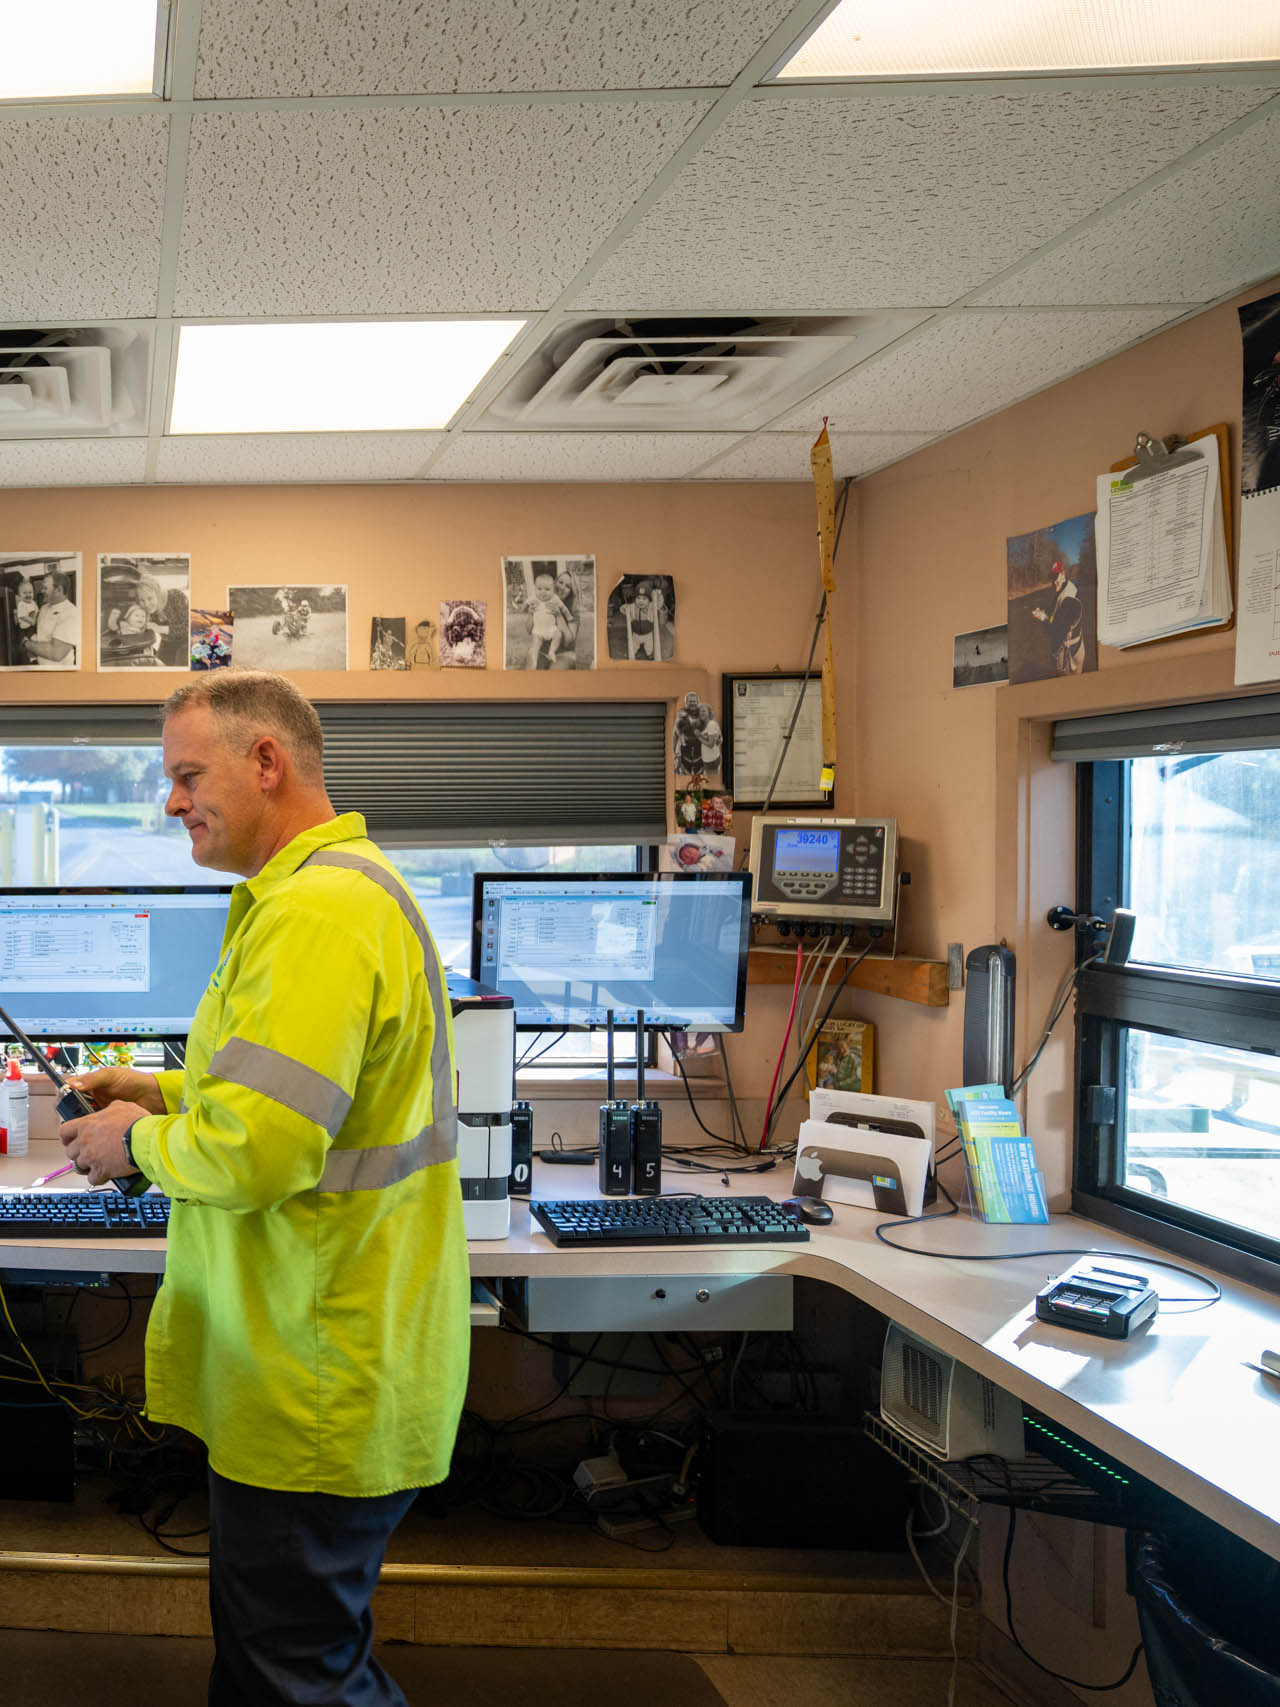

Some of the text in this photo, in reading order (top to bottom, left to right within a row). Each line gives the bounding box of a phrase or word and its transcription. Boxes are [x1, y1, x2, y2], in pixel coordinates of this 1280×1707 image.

[797, 834, 828, 845] 39240
[613, 1163, 622, 1178] 4
[646, 1162, 656, 1177] 5
[474, 1186, 480, 1196] 1
